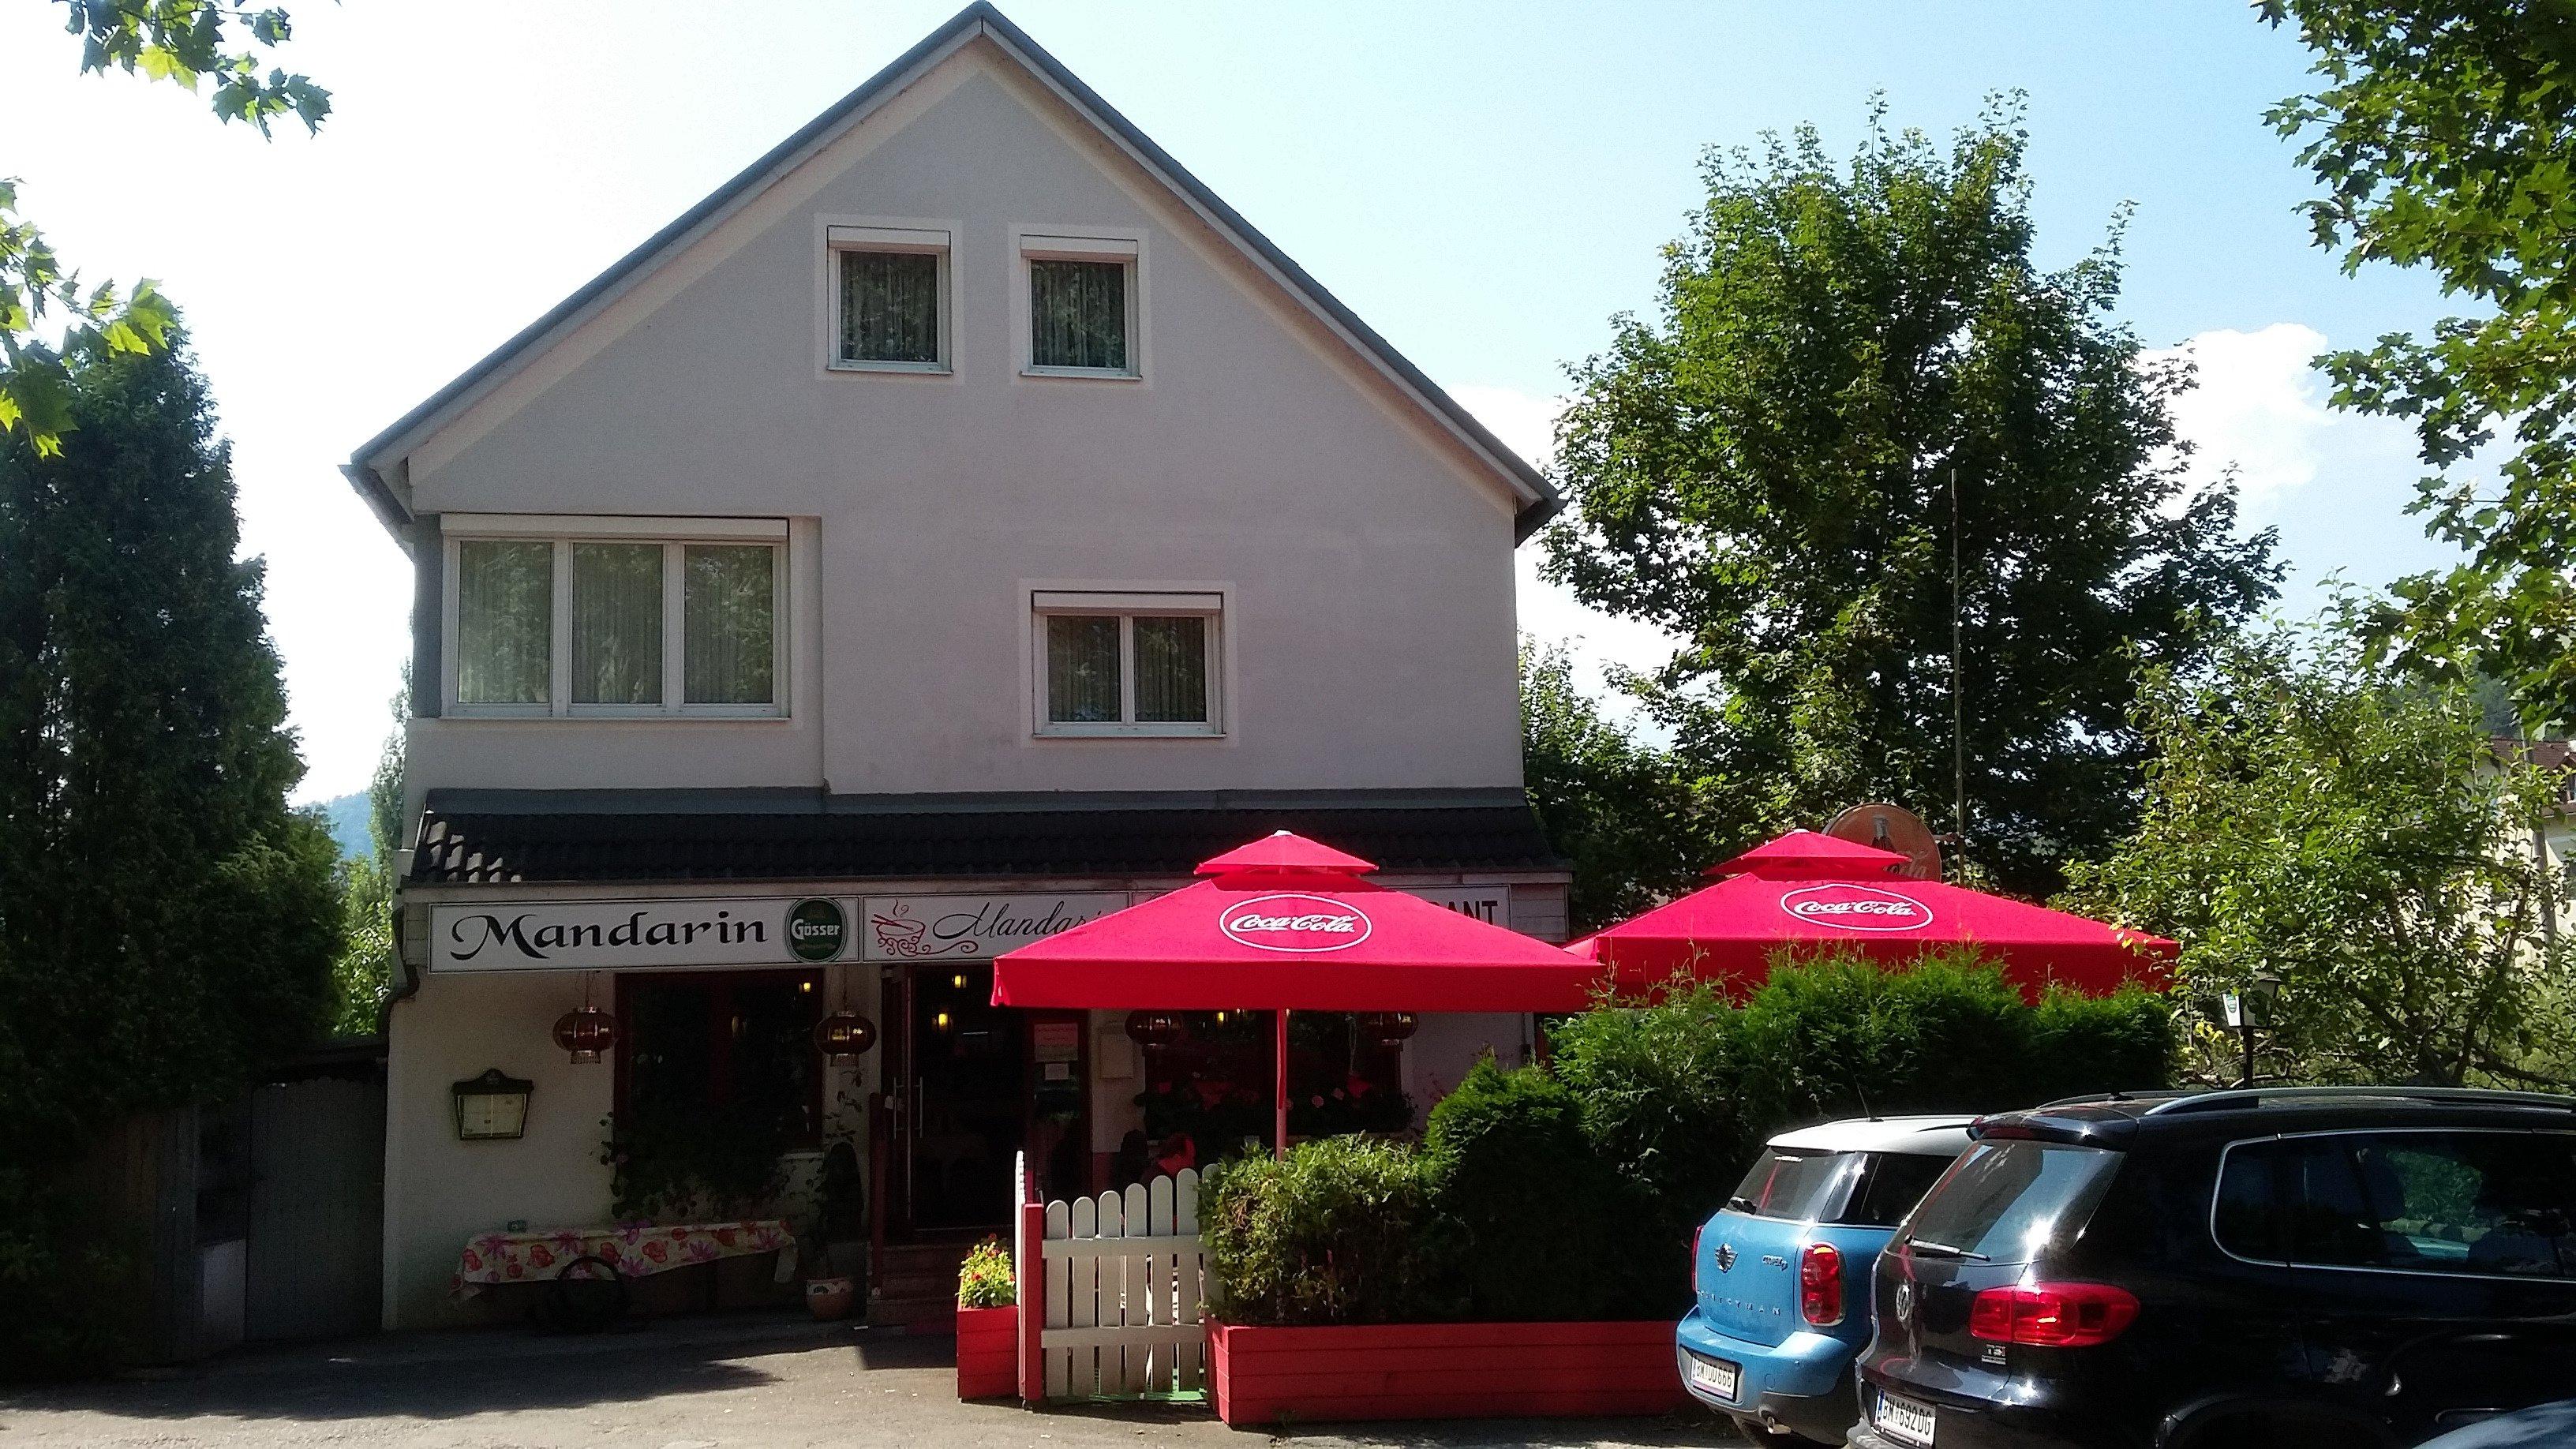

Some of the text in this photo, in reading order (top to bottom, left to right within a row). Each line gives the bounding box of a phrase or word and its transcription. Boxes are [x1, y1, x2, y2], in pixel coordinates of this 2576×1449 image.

[1794, 900, 1917, 917] Coca-Cola
[792, 919, 840, 939] Gösser
[933, 900, 1102, 939] Mandar
[1230, 914, 1359, 933] Coca-Cola
[450, 911, 769, 960] Mandarin
